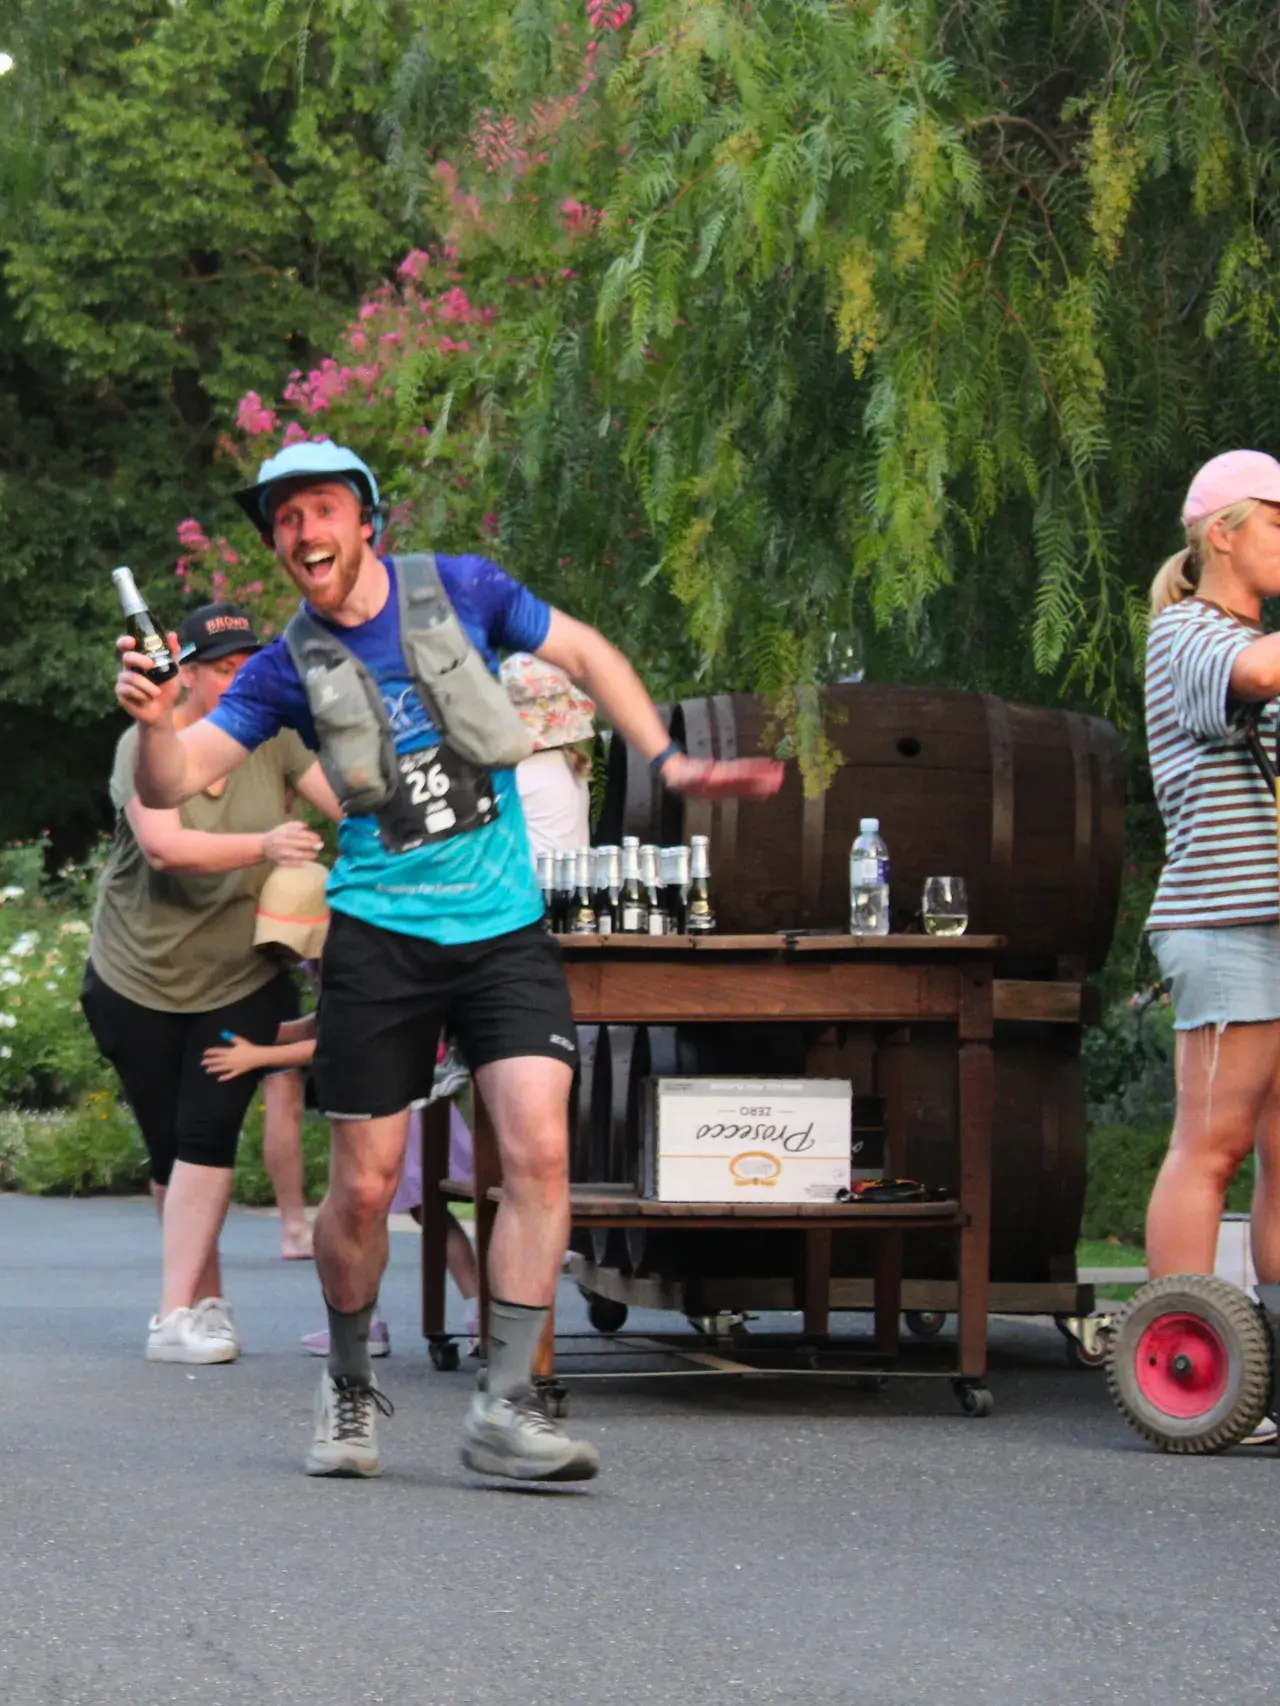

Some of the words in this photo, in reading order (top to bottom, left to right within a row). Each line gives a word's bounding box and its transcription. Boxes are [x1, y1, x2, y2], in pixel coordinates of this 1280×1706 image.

[406, 763, 450, 805] 26
[740, 1106, 772, 1117] ZERO
[696, 1122, 815, 1152] Prosecco
